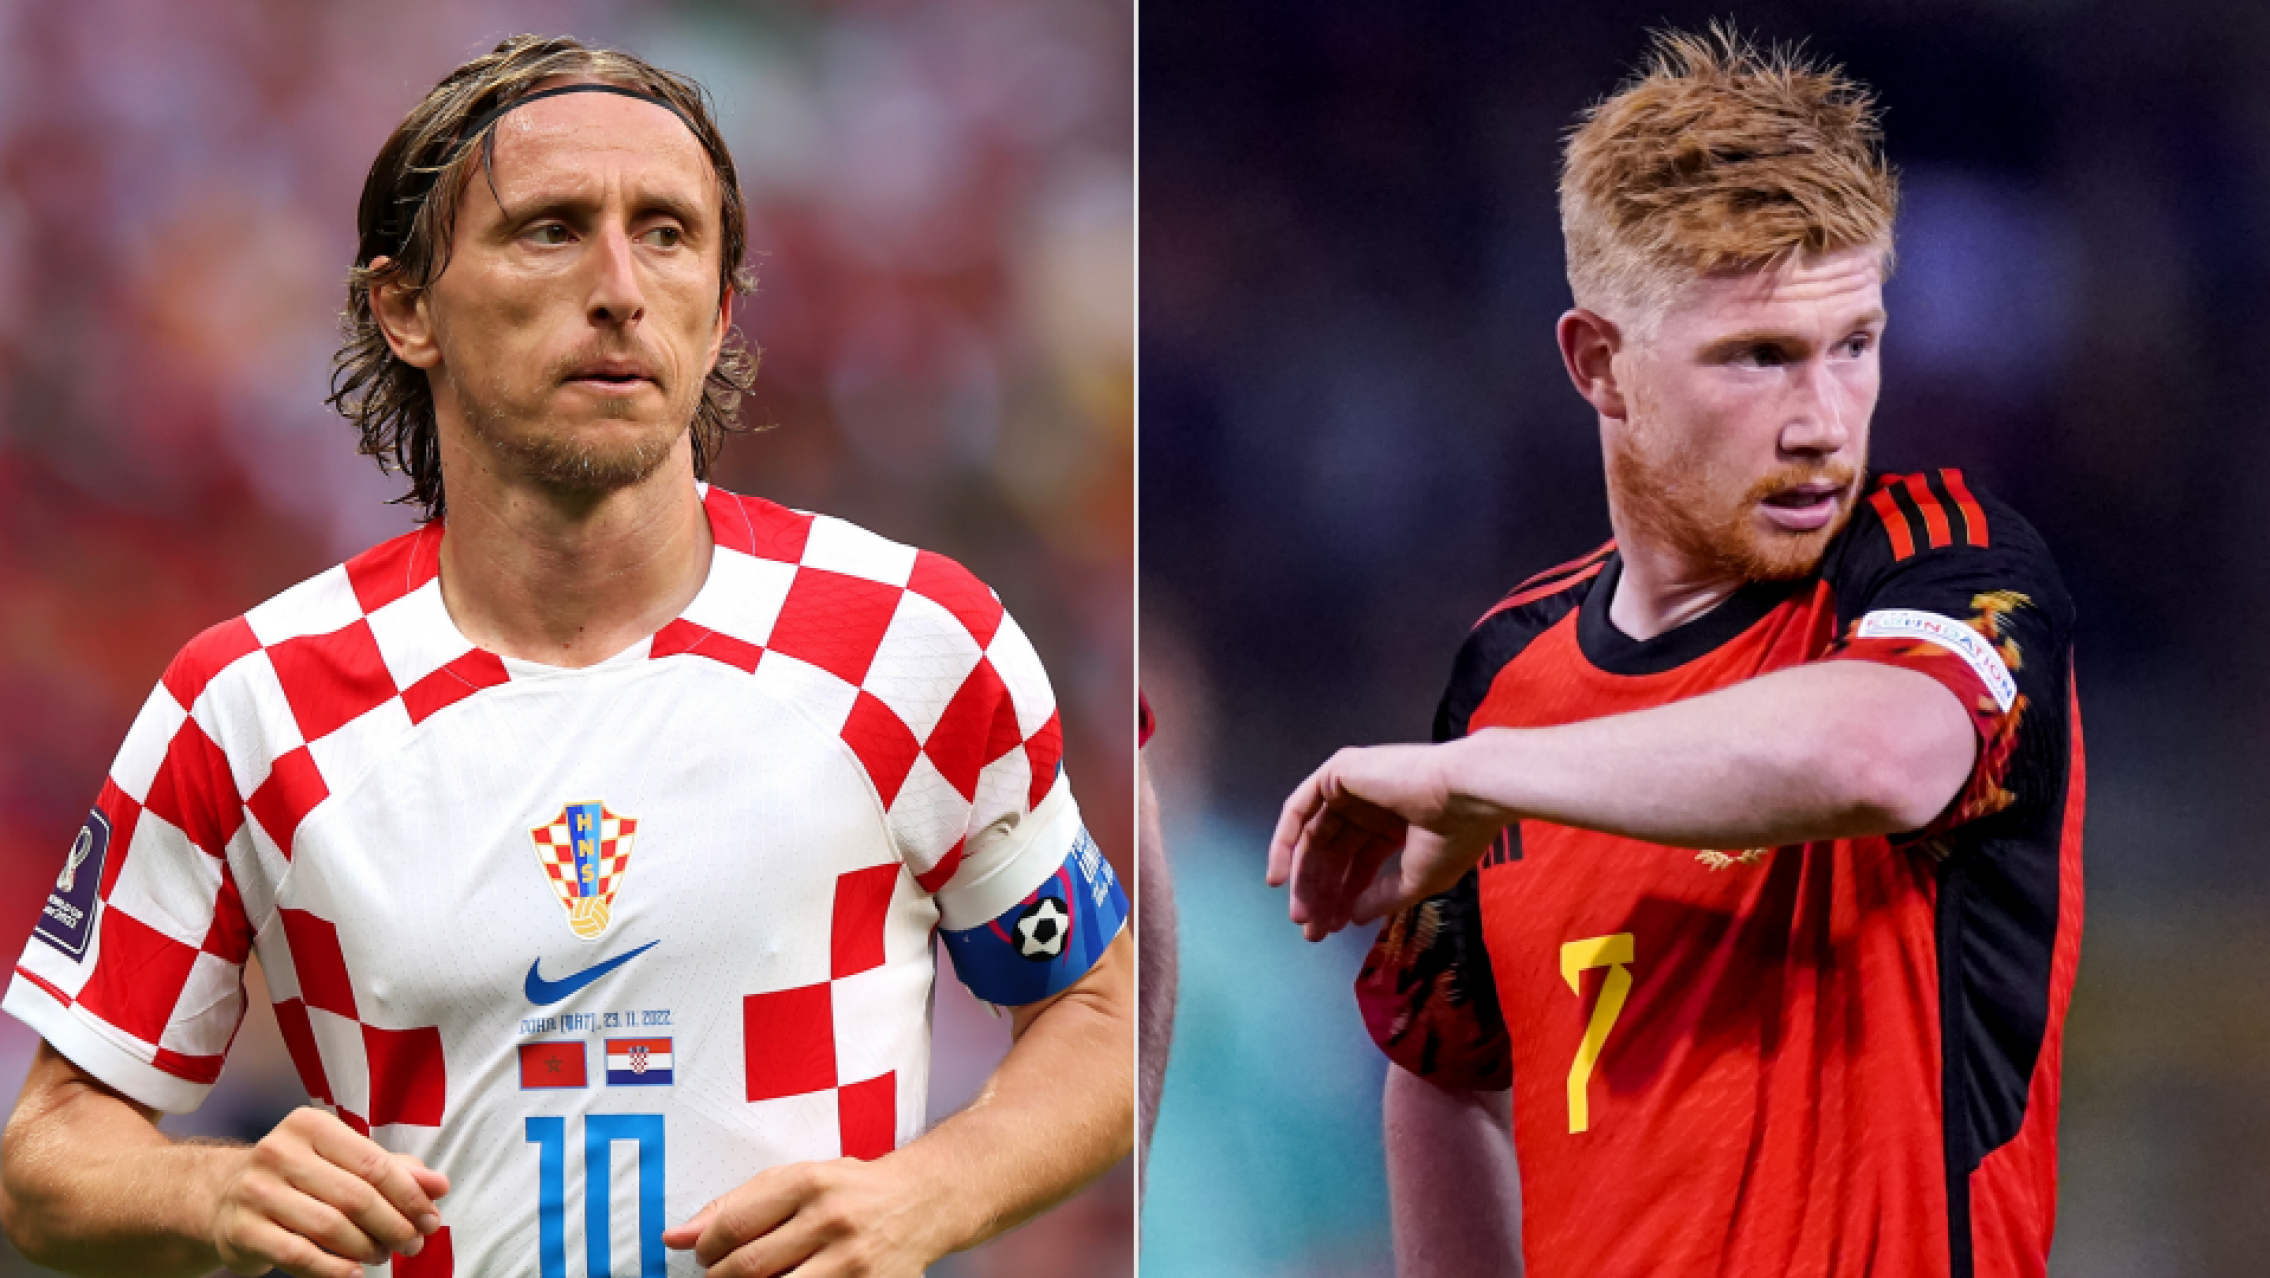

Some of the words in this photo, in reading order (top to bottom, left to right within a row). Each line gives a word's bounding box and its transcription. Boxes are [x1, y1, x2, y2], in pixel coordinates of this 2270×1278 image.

[577, 813, 595, 883] HNS
[1559, 933, 1634, 1135] 7
[525, 1113, 668, 1278] 10
